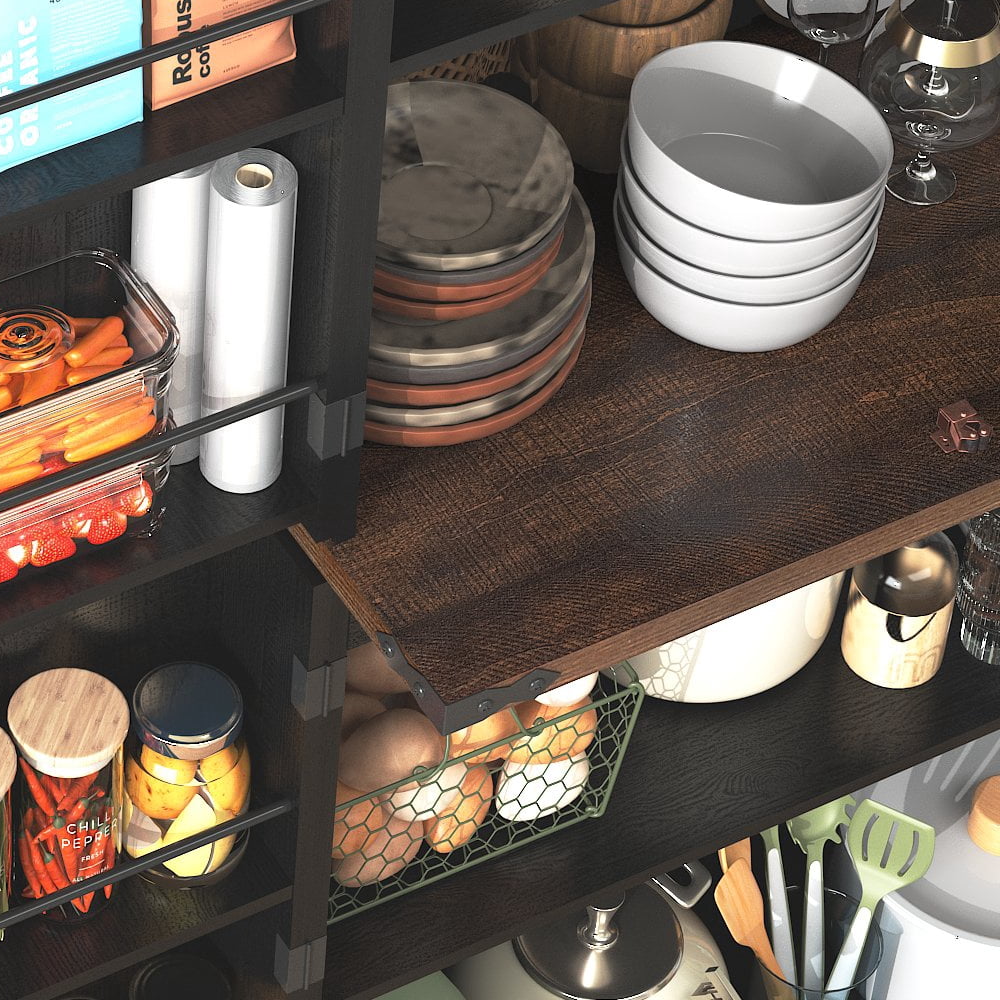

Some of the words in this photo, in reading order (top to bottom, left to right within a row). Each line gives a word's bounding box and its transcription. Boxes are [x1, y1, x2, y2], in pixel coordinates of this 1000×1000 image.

[17, 15, 40, 146] ORANIC
[61, 818, 118, 849] PEPPER
[81, 849, 104, 863] FRESH
